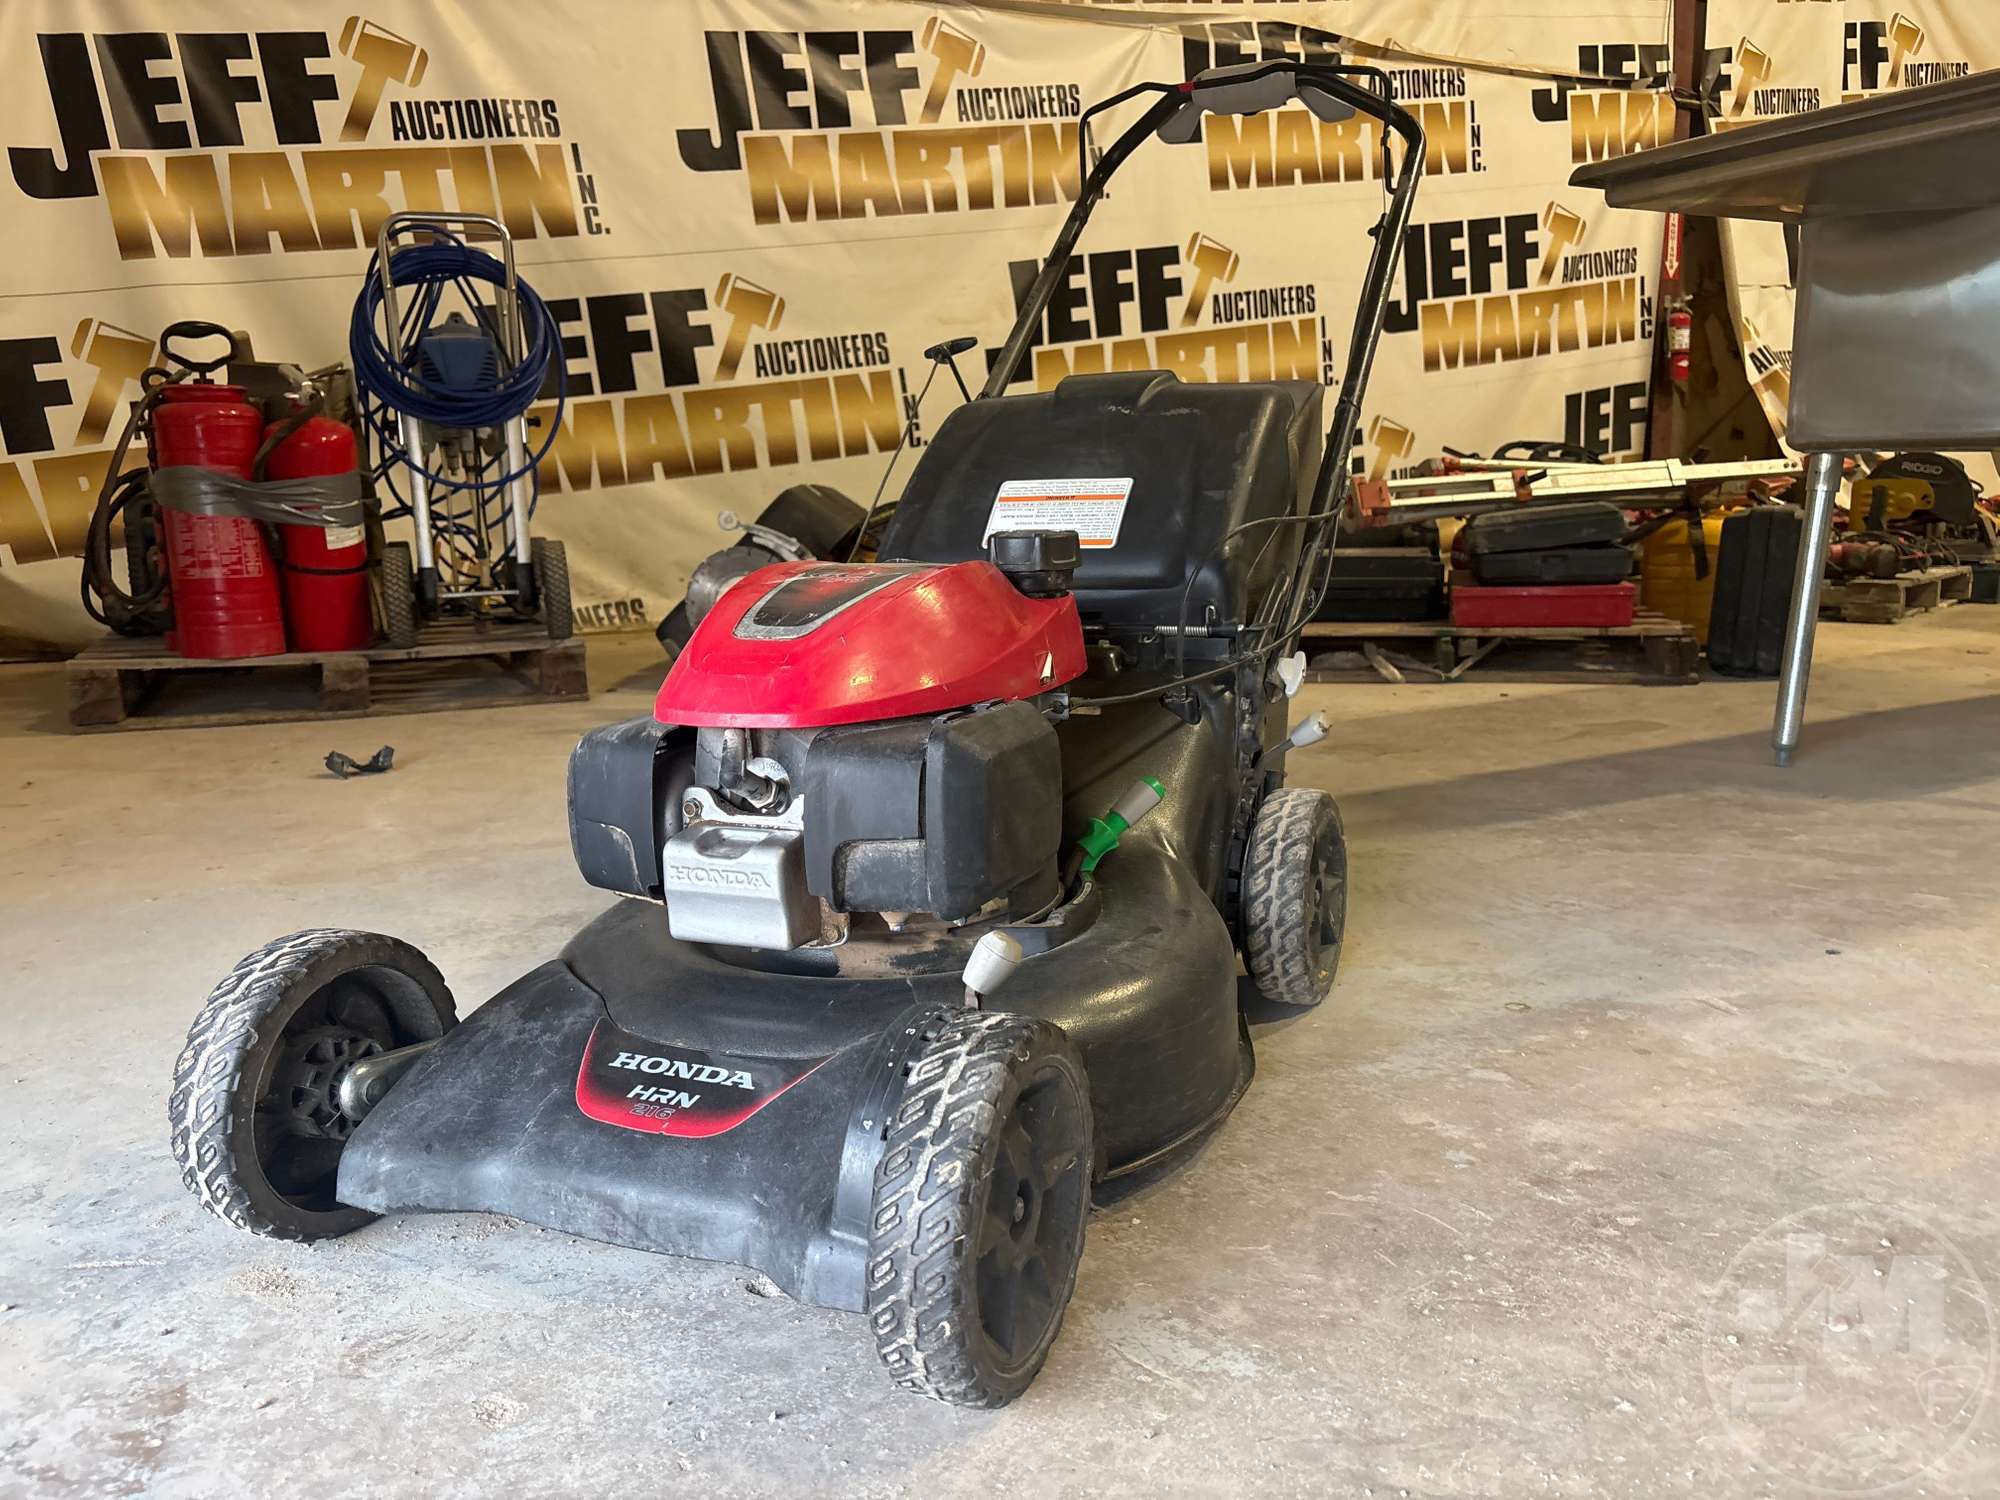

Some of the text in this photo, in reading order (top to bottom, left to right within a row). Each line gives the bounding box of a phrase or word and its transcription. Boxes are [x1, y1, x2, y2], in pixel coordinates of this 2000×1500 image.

[7, 32, 340, 200] JEFF
[389, 99, 561, 142] AUCTIONEERS
[676, 31, 919, 172] JEFF
[957, 84, 1080, 123] AUCTIONEERS
[744, 122, 1081, 226] MARTIN
[97, 144, 580, 261] MARTIN
[1383, 213, 1539, 333] JEFF
[1562, 247, 1638, 284] AUCTIONEERS
[1212, 284, 1316, 325] AUCTIONEERS
[1421, 277, 1637, 374] MARTIN
[754, 332, 890, 379] AUCTIONEERS
[530, 370, 899, 497] MARTIN
[670, 865, 771, 888] HONDA
[608, 1051, 756, 1091] HONDA
[626, 1084, 701, 1109] HRN
[629, 1103, 676, 1120] 216
